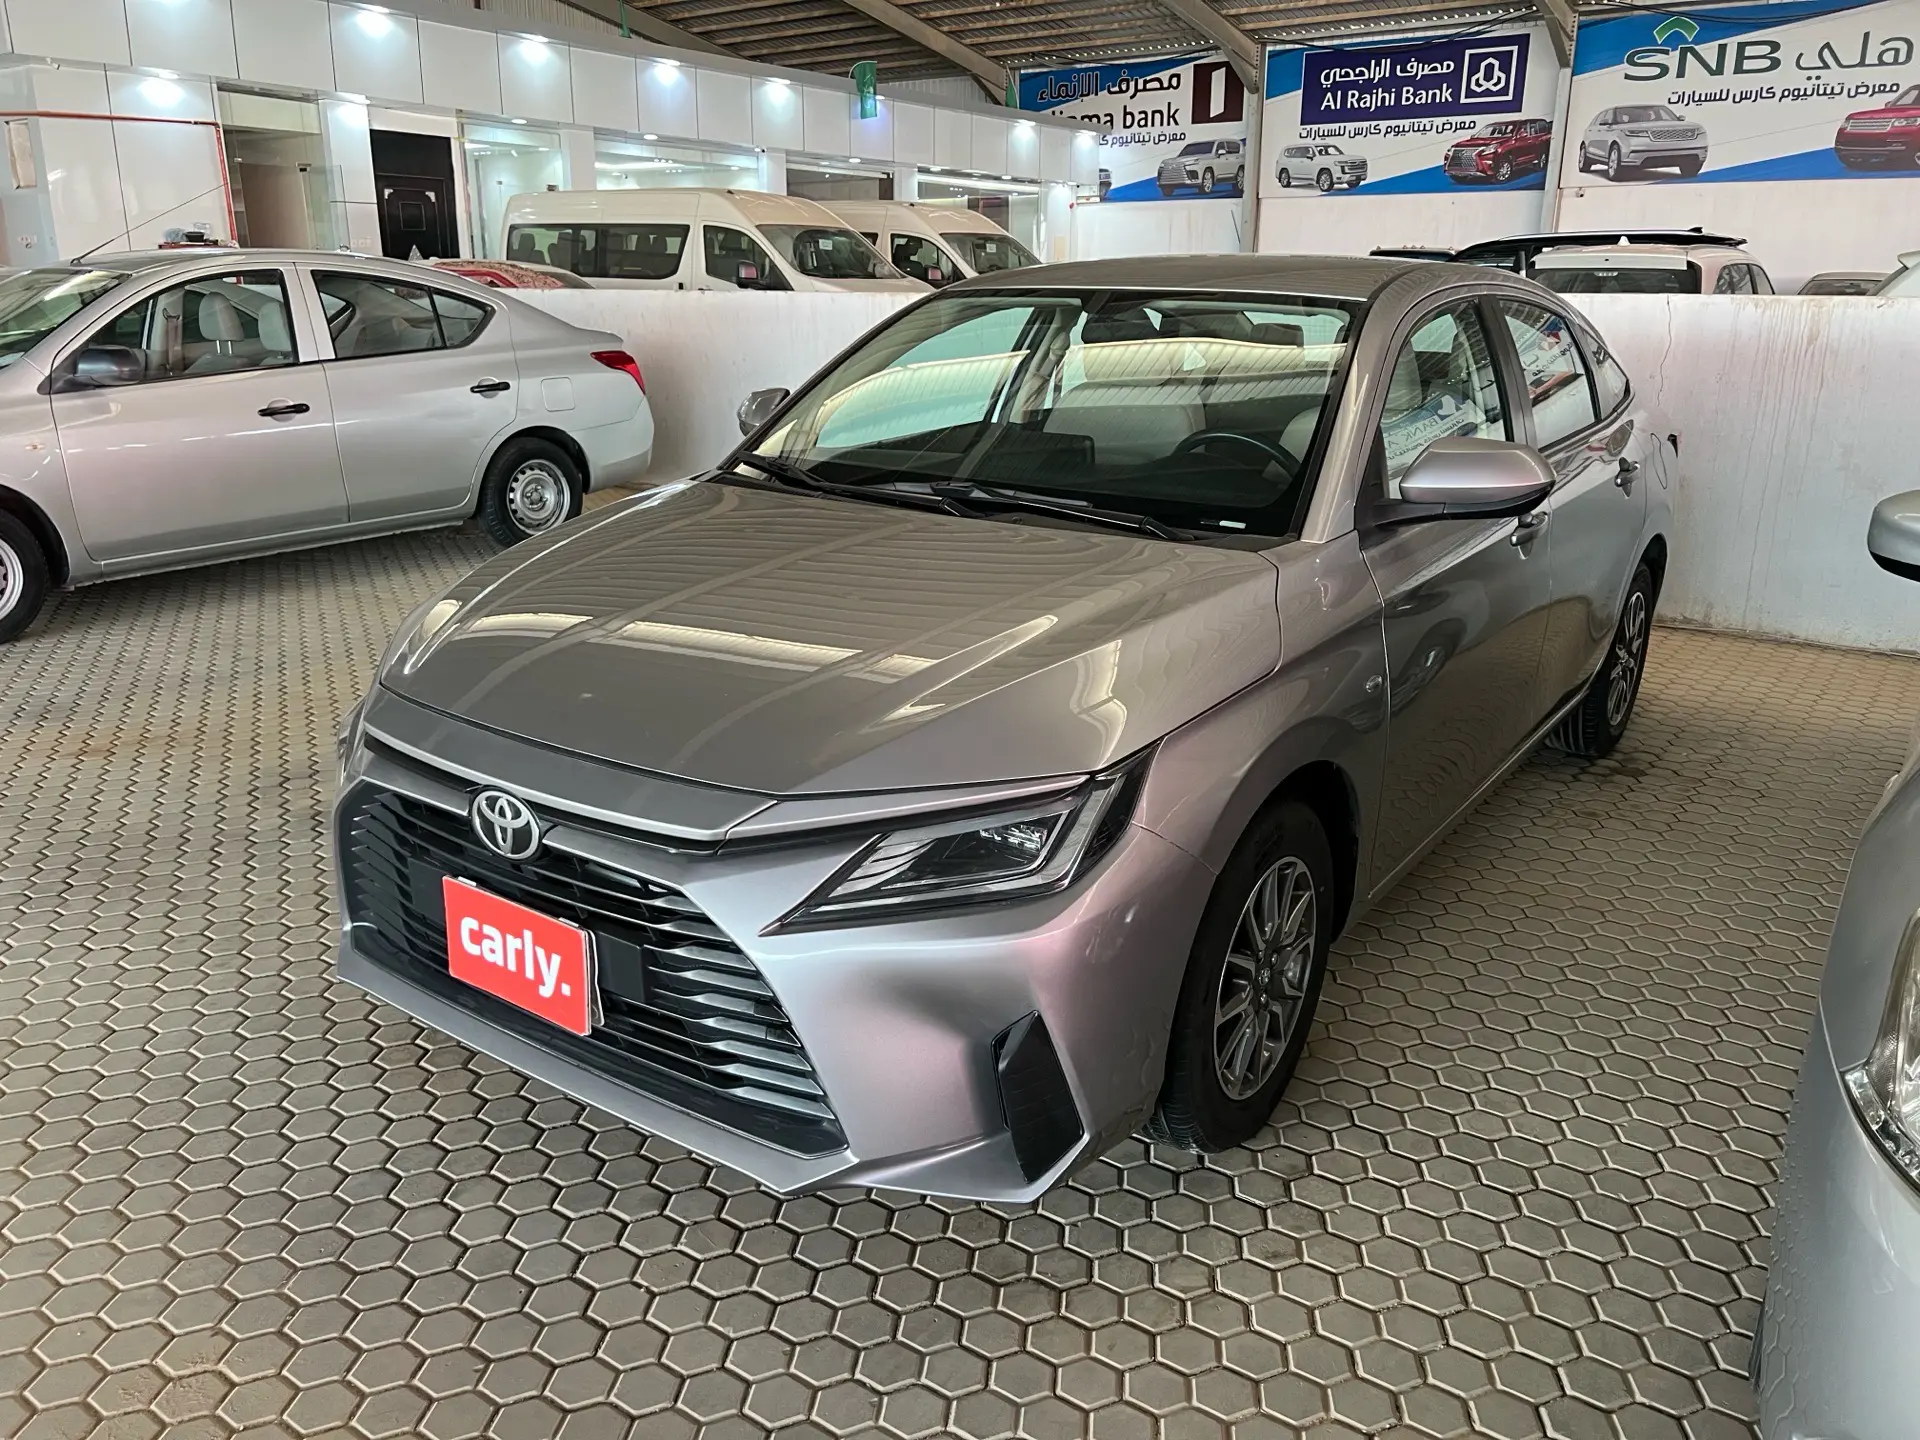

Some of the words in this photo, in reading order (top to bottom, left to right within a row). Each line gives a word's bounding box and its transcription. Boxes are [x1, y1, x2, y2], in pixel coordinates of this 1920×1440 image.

[1396, 57, 1455, 80] مصرف
[1623, 40, 1781, 82] SNB
[1320, 58, 1391, 88] الراجحي
[1107, 69, 1181, 99] مصرف
[1779, 82, 1844, 102] تيتانيوم
[1847, 82, 1900, 98] معرض
[1320, 90, 1341, 111] Al
[1347, 87, 1396, 113] Rajhi
[1402, 83, 1453, 105] Bank
[1667, 89, 1730, 107] للسيارات
[1732, 86, 1776, 104] كارس
[1122, 101, 1180, 129] bank
[1300, 126, 1346, 141] للسيارات
[1348, 124, 1382, 138] كارس
[1384, 120, 1434, 137] تيتانيوم
[1436, 119, 1476, 134] معرض
[1110, 132, 1152, 148] تيتانيوم
[1153, 131, 1187, 145] معرض
[460, 916, 571, 998] carly.
